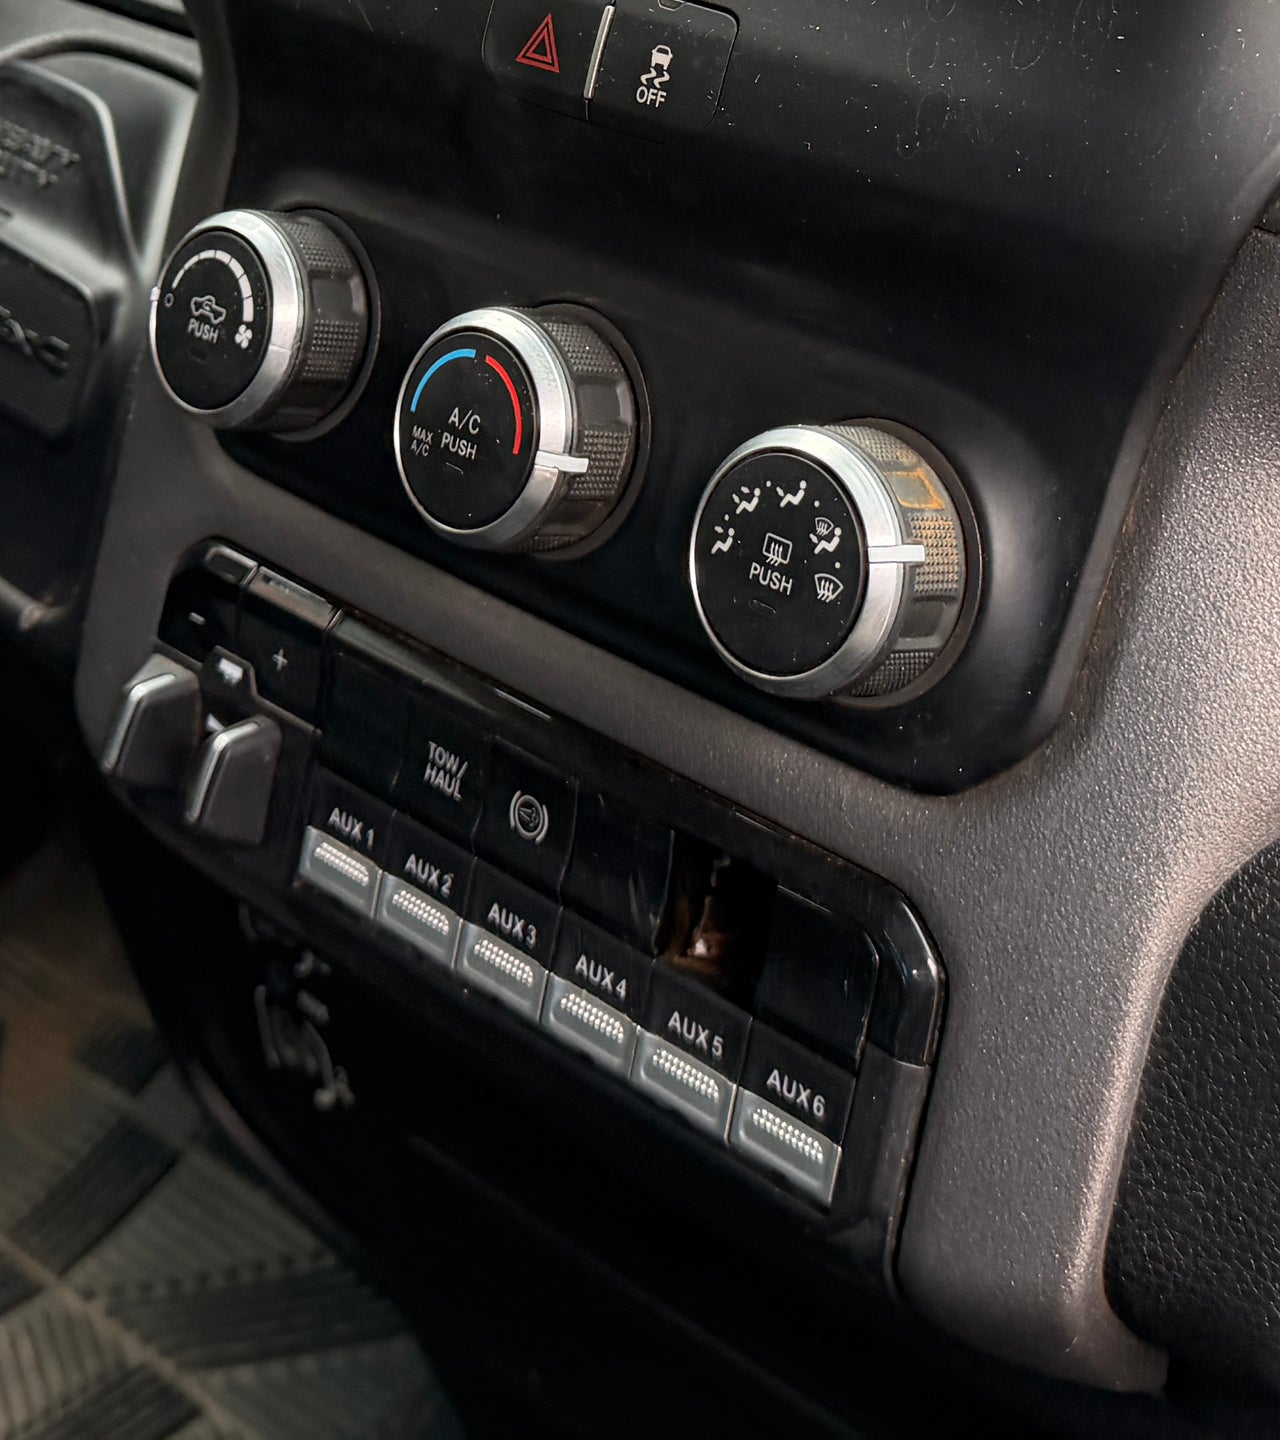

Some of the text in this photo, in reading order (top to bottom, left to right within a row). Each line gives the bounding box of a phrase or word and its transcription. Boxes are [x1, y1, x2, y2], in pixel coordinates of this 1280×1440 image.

[635, 85, 668, 109] OFF
[187, 318, 220, 345] PUSH
[411, 424, 434, 446] MAX
[448, 406, 481, 436] A/C
[409, 439, 430, 457] A/C
[441, 431, 478, 461] PUSH
[749, 561, 793, 596] PUSH
[427, 740, 469, 780] TOW/
[423, 761, 463, 802] HAUL
[327, 806, 376, 850] AUX 1
[404, 853, 455, 898] AUX 2
[487, 902, 539, 950] AUX 3
[574, 954, 628, 1003] AUX 4
[667, 1010, 725, 1058] AUX 5
[766, 1067, 827, 1118] AUX 6
